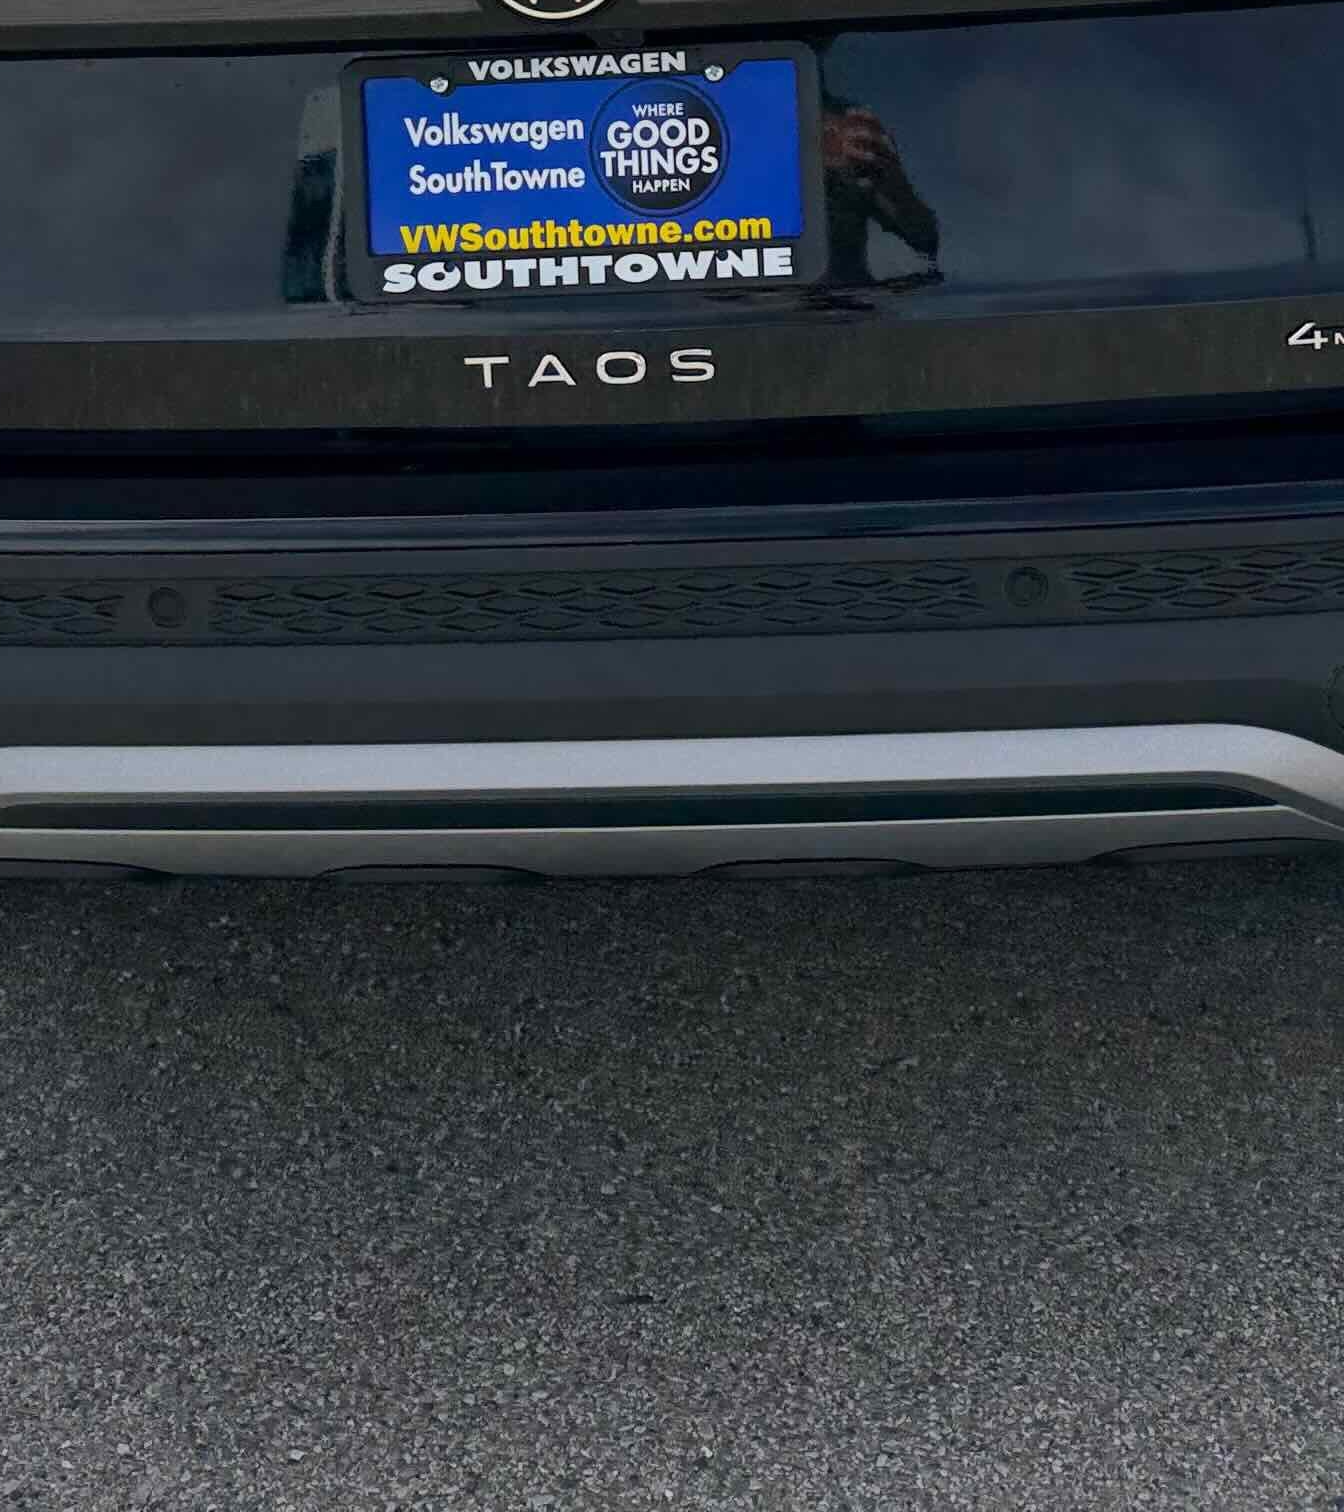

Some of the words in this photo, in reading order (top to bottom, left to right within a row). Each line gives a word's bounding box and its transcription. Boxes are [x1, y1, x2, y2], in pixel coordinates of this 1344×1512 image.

[468, 51, 687, 81] VOLKSWAGEN
[632, 103, 684, 118] WHERE
[403, 112, 585, 150] Volkswagen
[607, 118, 710, 150] GOOD
[599, 145, 719, 177] THINGS
[632, 178, 691, 194] HAPPEN
[400, 216, 772, 254] VWSouthtowne.com
[383, 246, 794, 294] SOUTHTOWNE
[464, 349, 716, 389] TAOS
